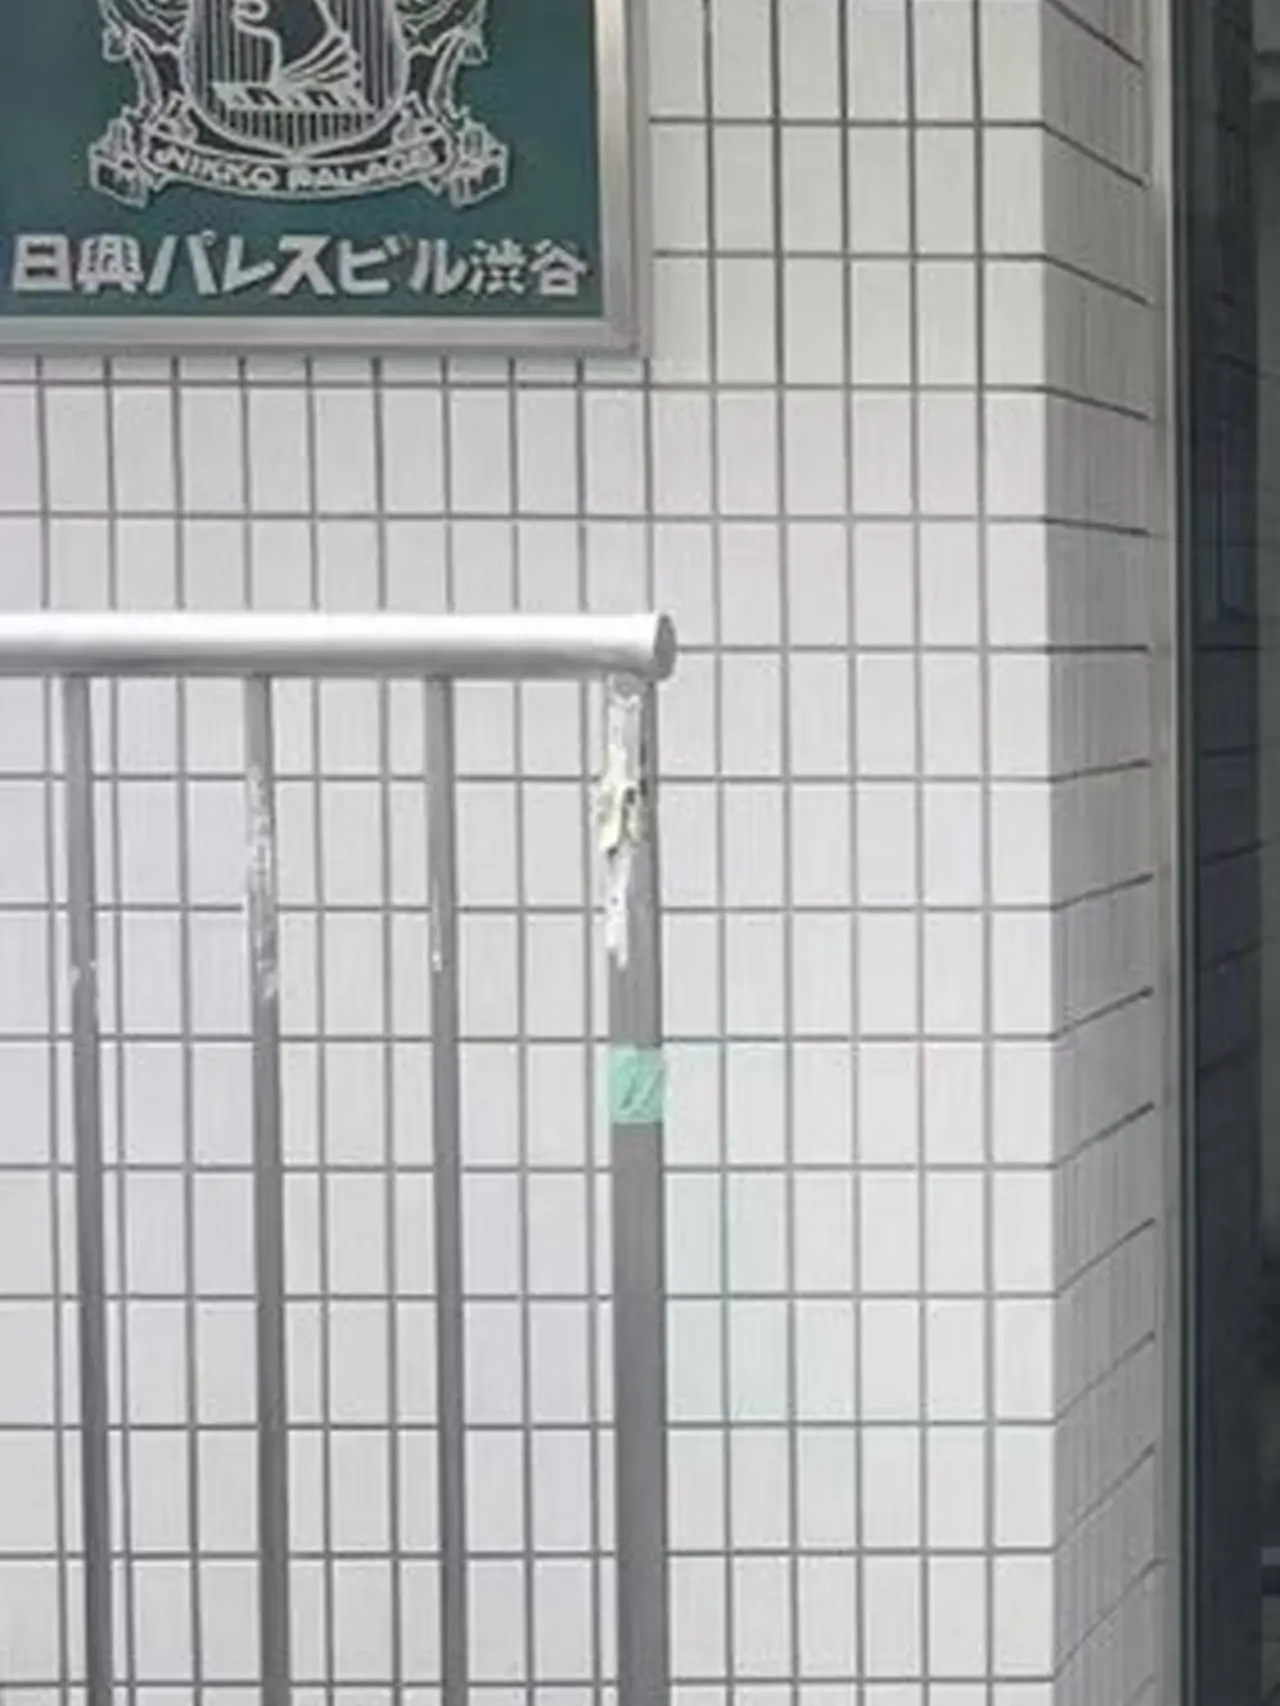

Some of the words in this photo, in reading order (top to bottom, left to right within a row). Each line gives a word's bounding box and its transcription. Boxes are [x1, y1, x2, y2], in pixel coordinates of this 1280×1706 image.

[12, 231, 588, 296] 日興パレスビル渋谷
